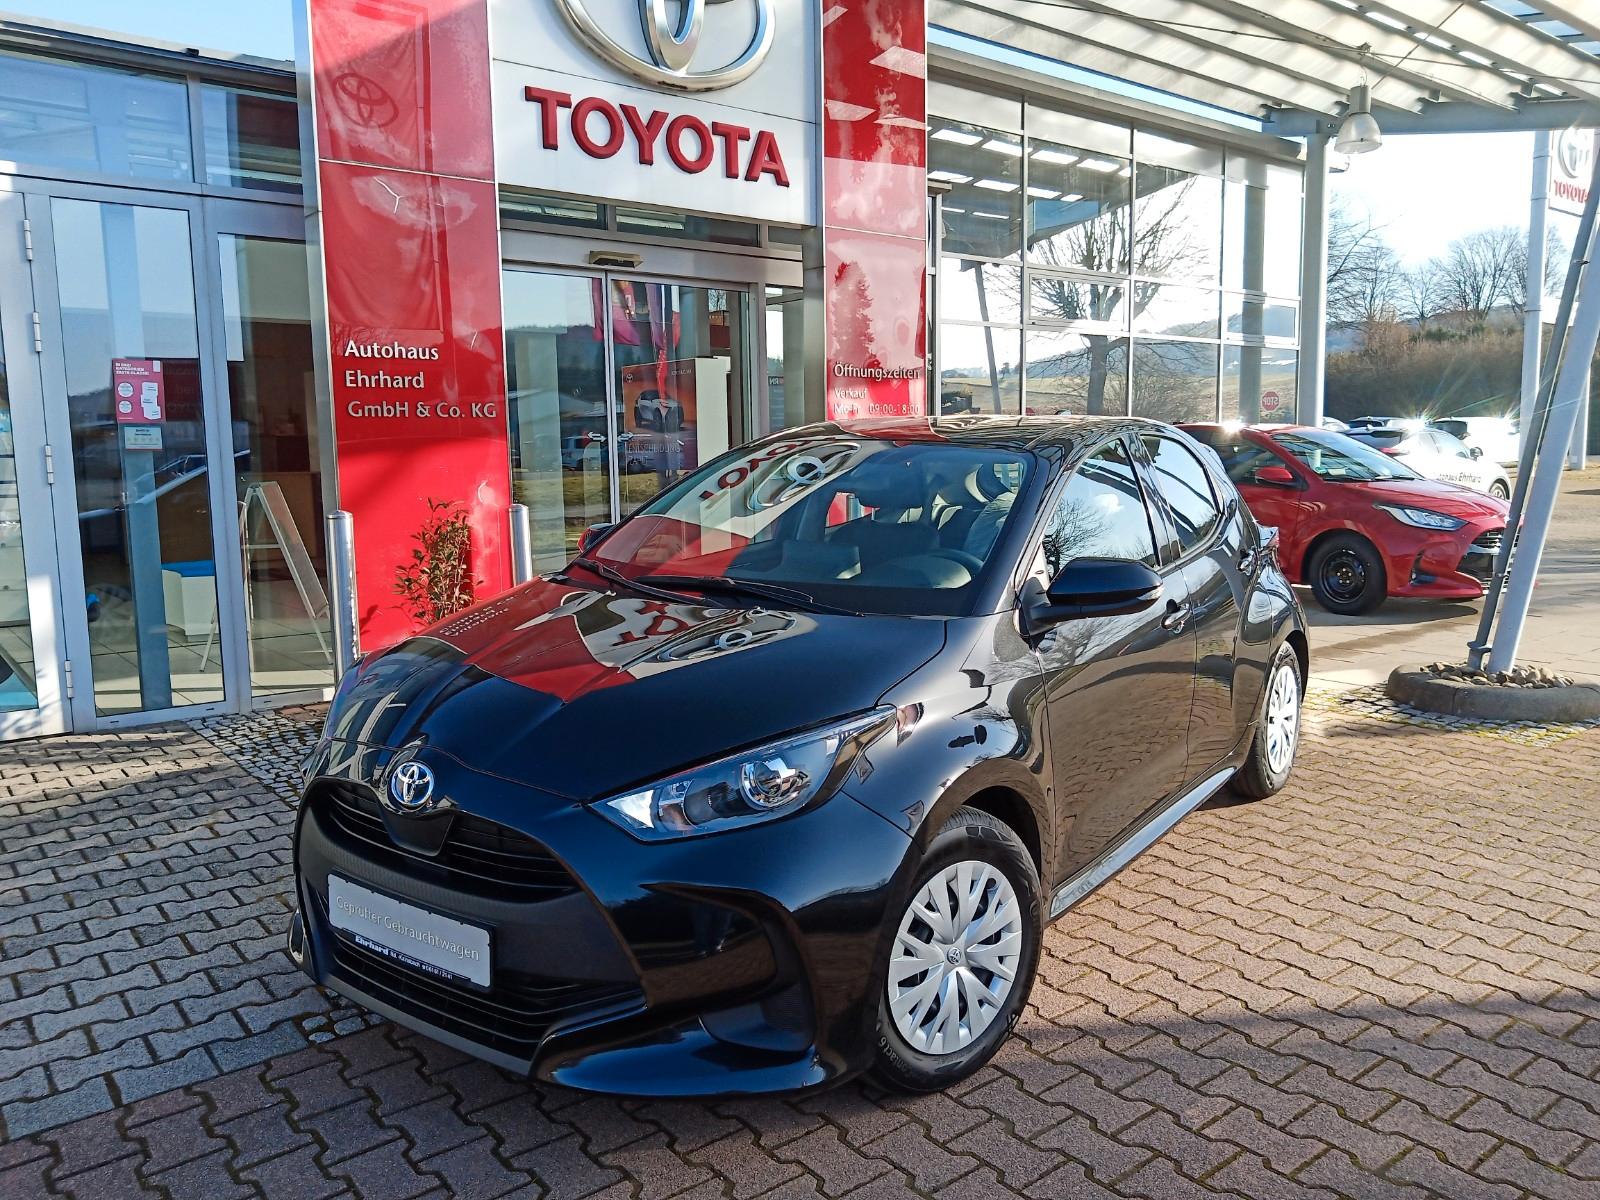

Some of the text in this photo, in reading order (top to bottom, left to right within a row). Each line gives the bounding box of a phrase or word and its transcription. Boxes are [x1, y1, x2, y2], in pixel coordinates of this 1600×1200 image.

[524, 85, 791, 188] TOYOTA
[344, 339, 439, 361] Autohaus
[345, 370, 425, 389] Ehrhard
[833, 361, 921, 382] Öffnungszeiten
[834, 387, 868, 399] Verkauf
[348, 401, 497, 418] GmbH & Co. KG
[354, 935, 389, 956] Ehrhard
[383, 916, 480, 961] Gebrauchtwagen
